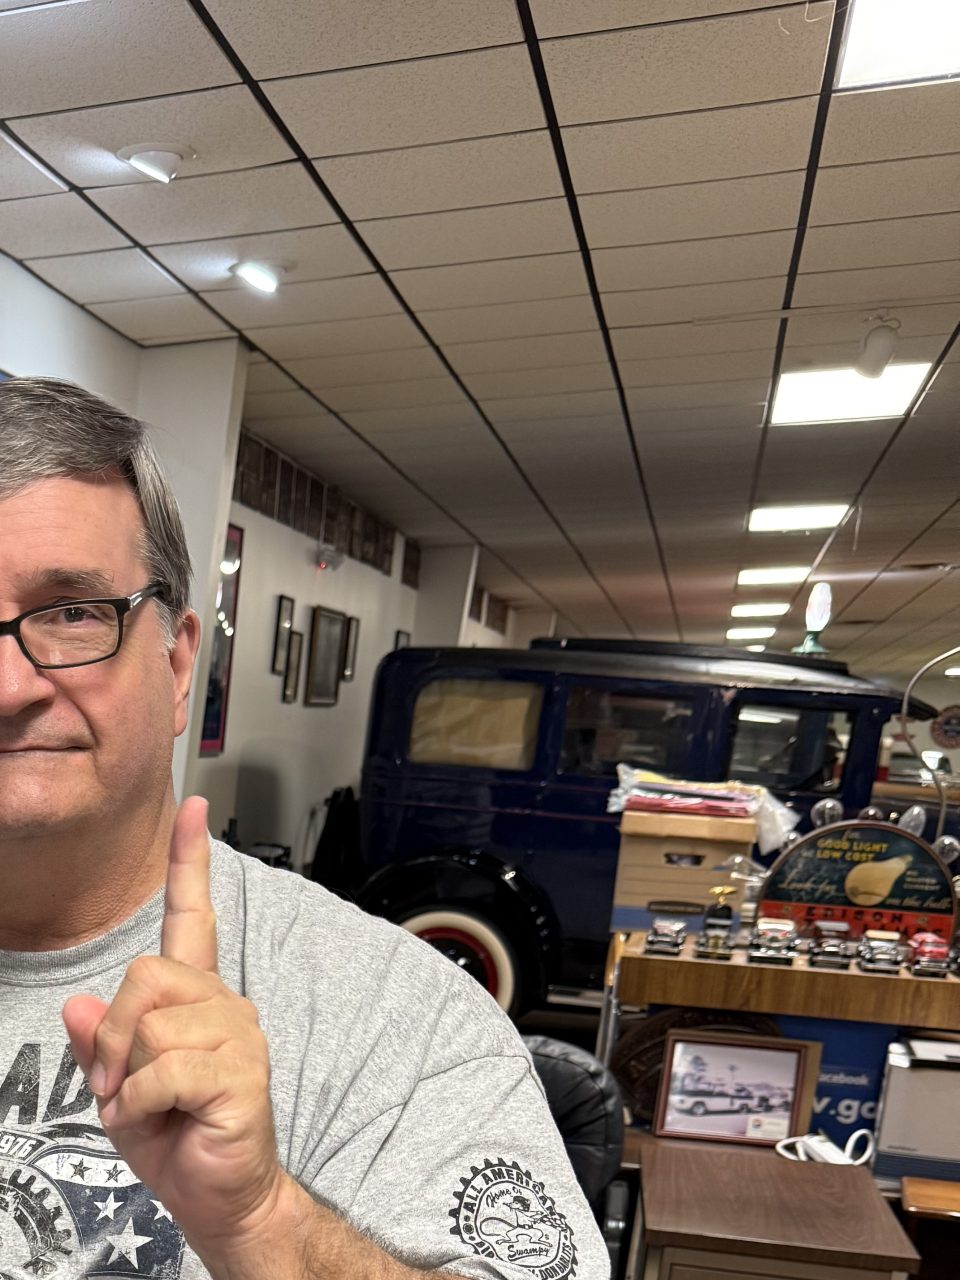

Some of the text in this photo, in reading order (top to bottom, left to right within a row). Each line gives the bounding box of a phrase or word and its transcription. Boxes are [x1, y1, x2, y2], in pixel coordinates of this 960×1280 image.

[816, 838, 889, 853] GOOD LIGHT
[815, 849, 841, 861] LOW
[844, 850, 875, 862] COST
[805, 906, 904, 923] EDISON
[463, 1167, 557, 1217] ALL AMERICAN
[485, 1189, 512, 1208] Home
[538, 1265, 561, 1280] DON
